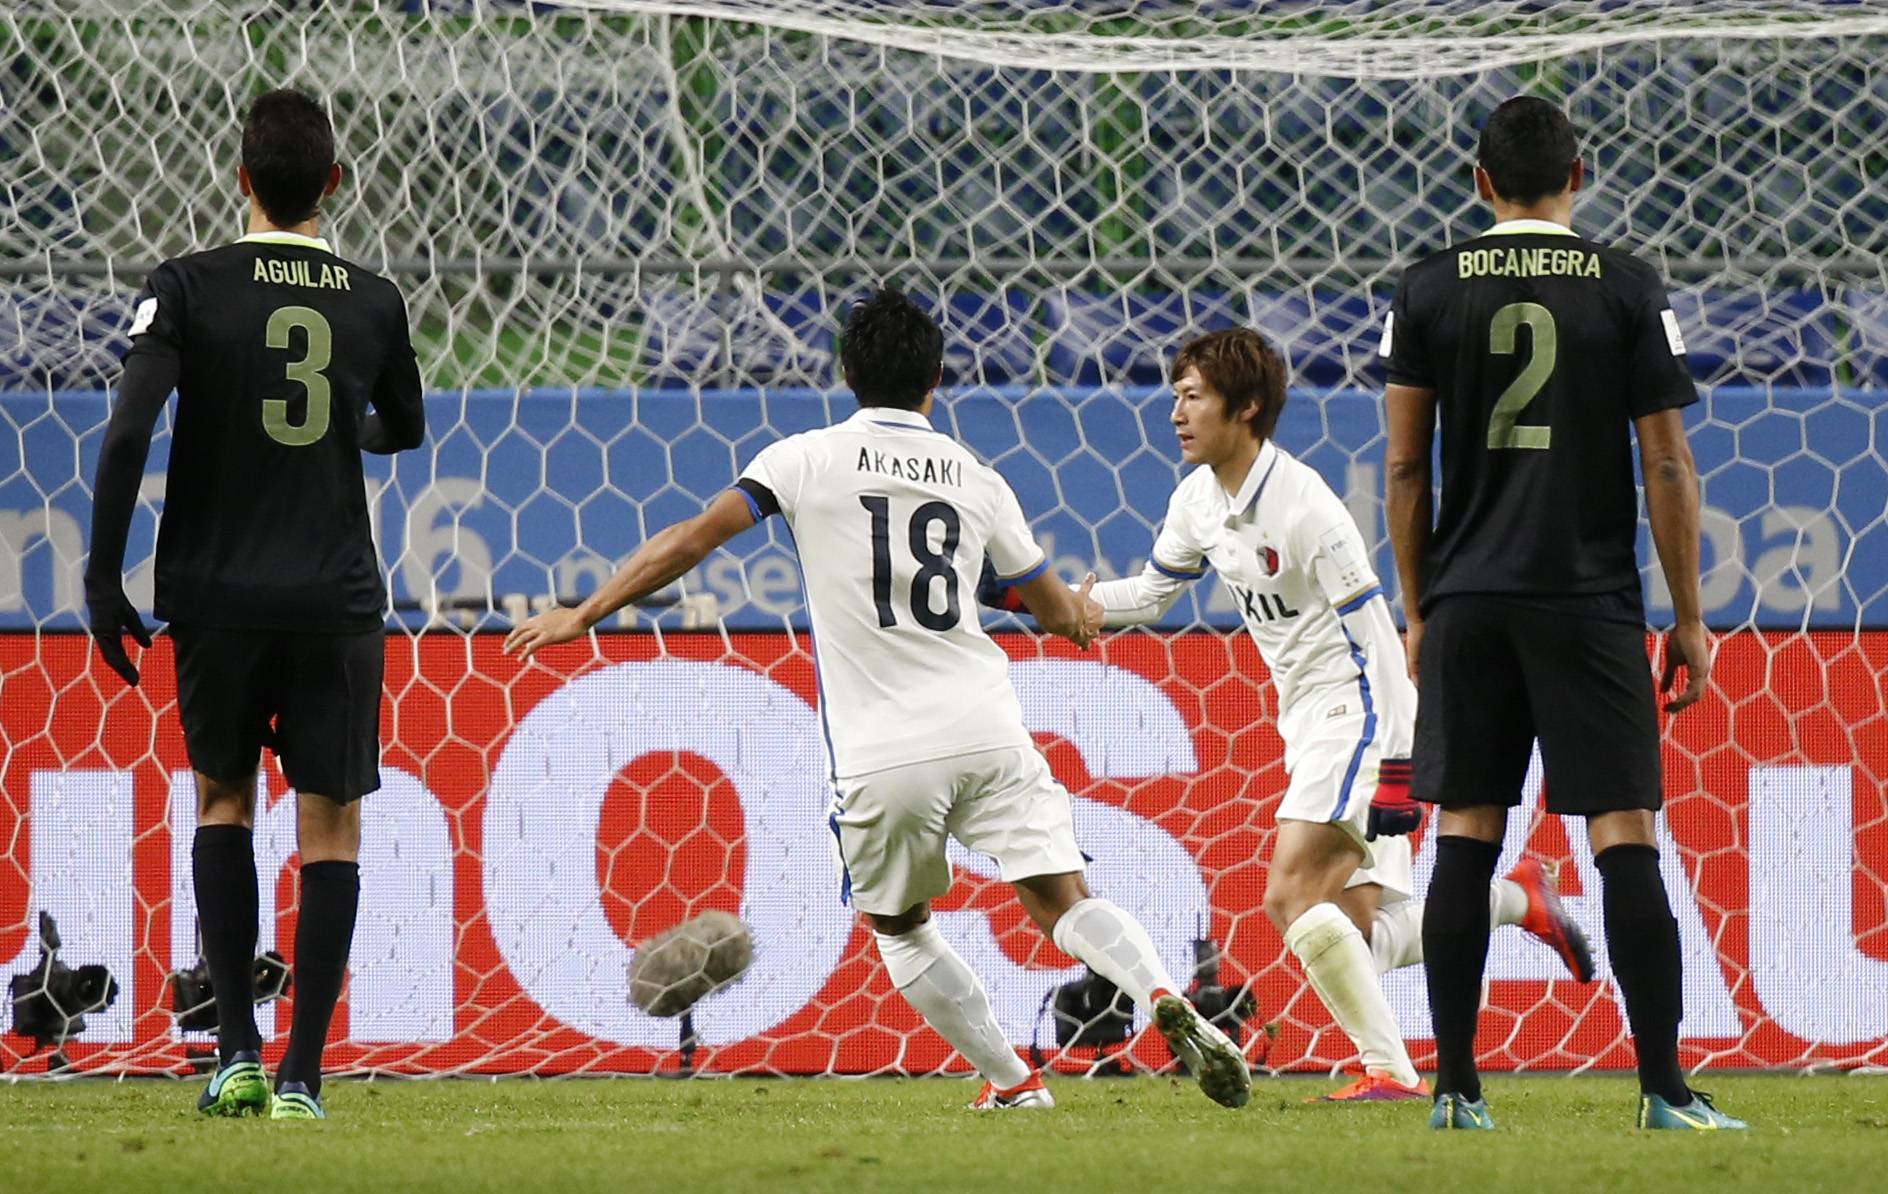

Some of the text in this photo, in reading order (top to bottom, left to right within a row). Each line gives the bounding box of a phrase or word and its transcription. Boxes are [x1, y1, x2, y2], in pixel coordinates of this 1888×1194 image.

[253, 257, 351, 291] AGUILAR
[1457, 248, 1601, 279] BOCANEGRA
[262, 306, 332, 446] 3
[1487, 302, 1557, 450] 2
[857, 447, 962, 488] AKASAKI
[858, 495, 961, 632] 18
